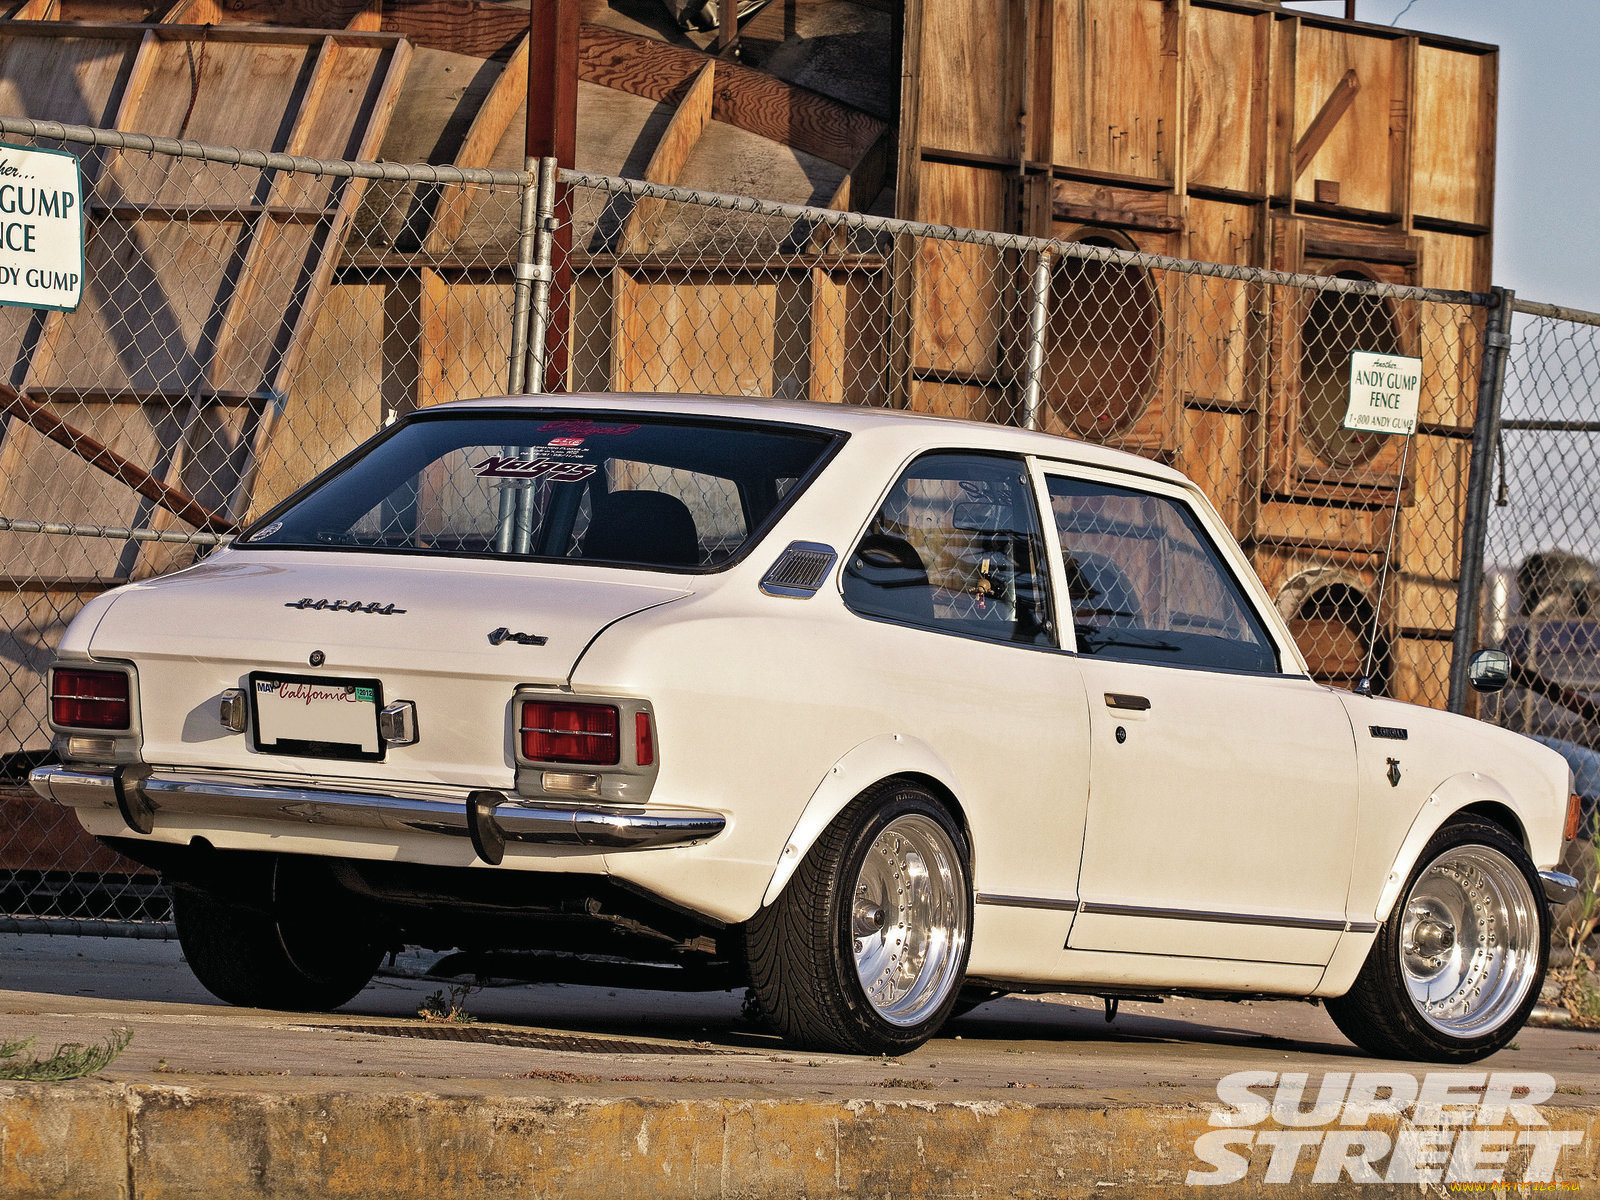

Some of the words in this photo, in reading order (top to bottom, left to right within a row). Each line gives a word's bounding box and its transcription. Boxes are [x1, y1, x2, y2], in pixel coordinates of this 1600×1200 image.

[0, 184, 75, 219] GUMP
[0, 222, 36, 252] CE
[26, 268, 78, 292] GUMP
[1355, 370, 1385, 387] ANDY
[1387, 373, 1417, 391] GUMP
[1370, 391, 1401, 409] FENCE
[1349, 413, 1370, 425] 1-800
[1371, 416, 1390, 427] ANDY
[1392, 417, 1414, 429] GUMP
[257, 682, 275, 693] MAY
[280, 682, 357, 706] California
[359, 689, 374, 697] 2012
